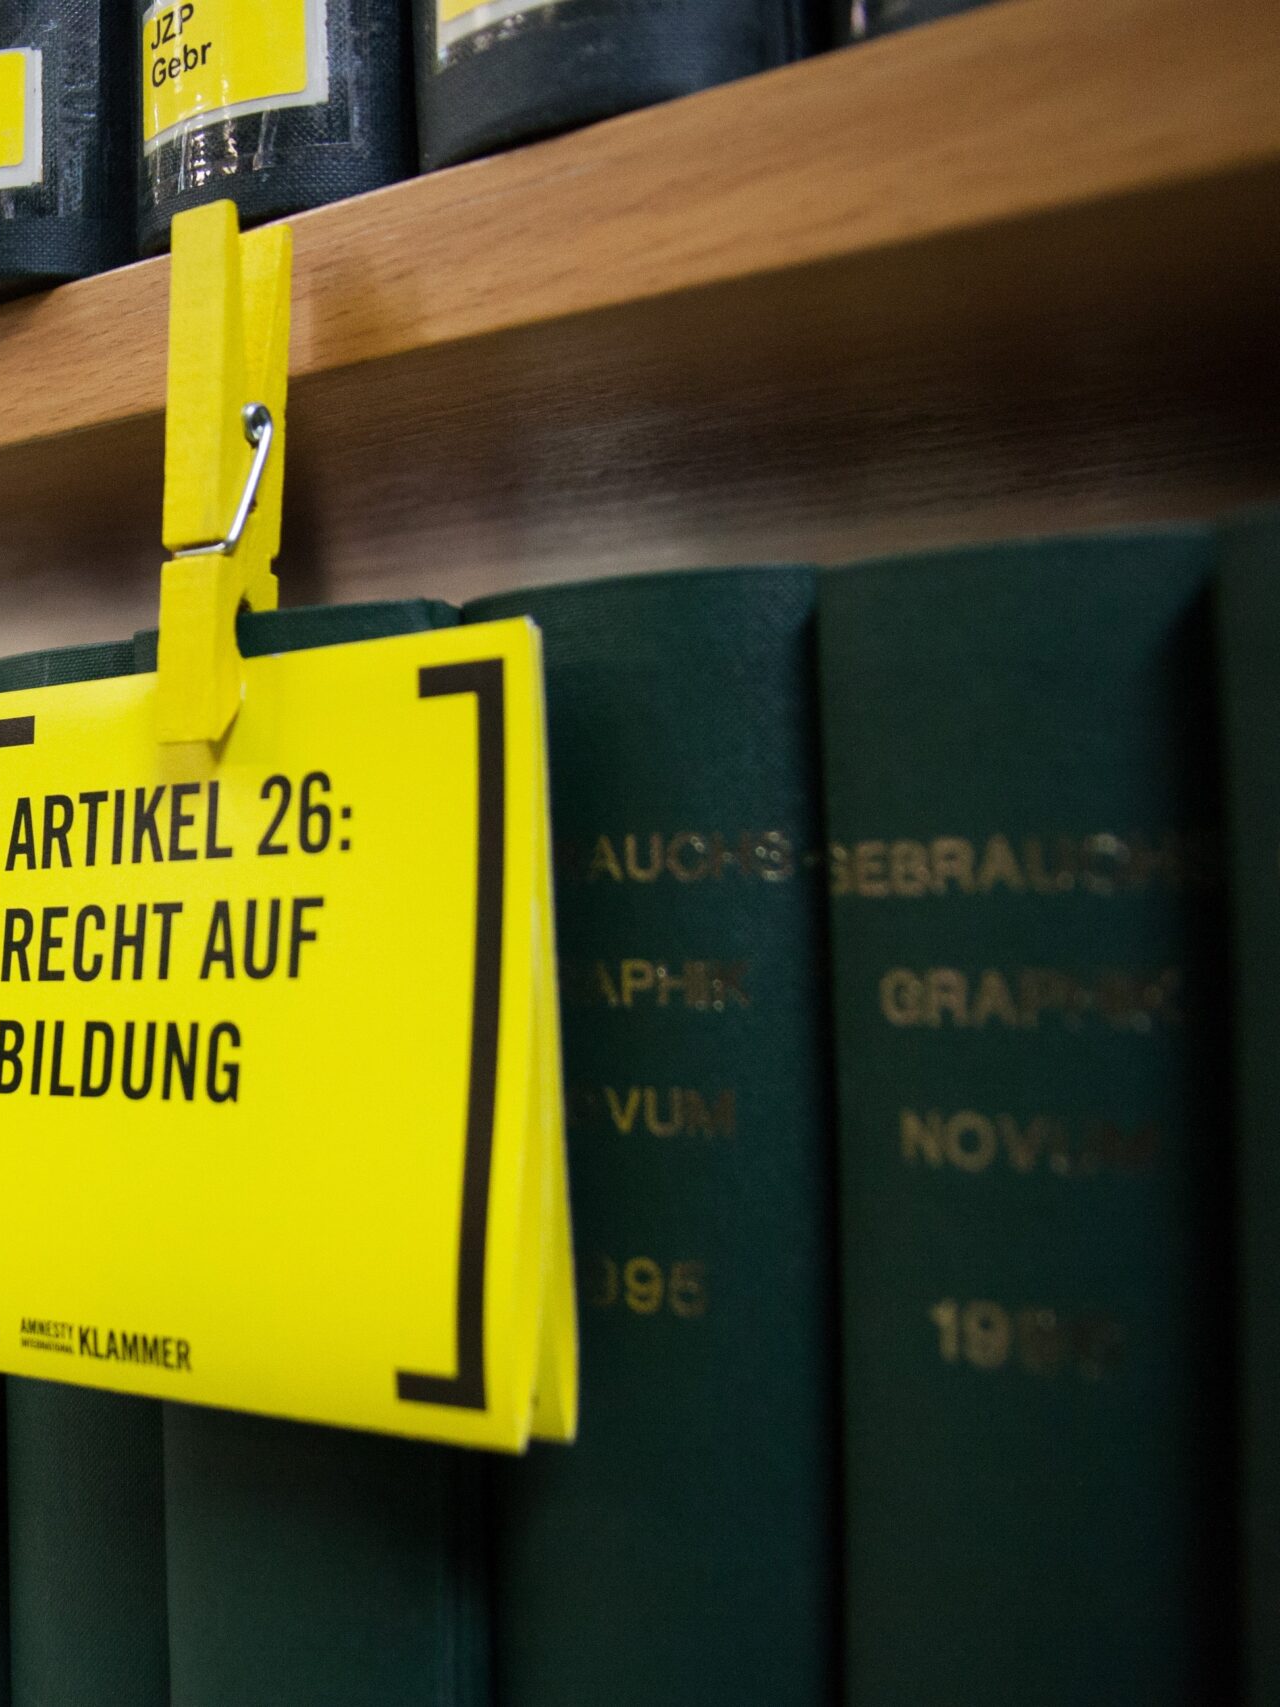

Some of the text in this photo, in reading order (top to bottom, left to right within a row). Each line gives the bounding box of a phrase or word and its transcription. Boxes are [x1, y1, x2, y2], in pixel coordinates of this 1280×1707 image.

[151, 2, 194, 50] JZP
[151, 41, 212, 88] Gebr
[4, 770, 354, 872] ARTIKEL 26:
[0, 895, 325, 983] RECHT AUF
[20, 1316, 73, 1341] AMNESTY
[78, 1324, 192, 1373] KLAMMER
